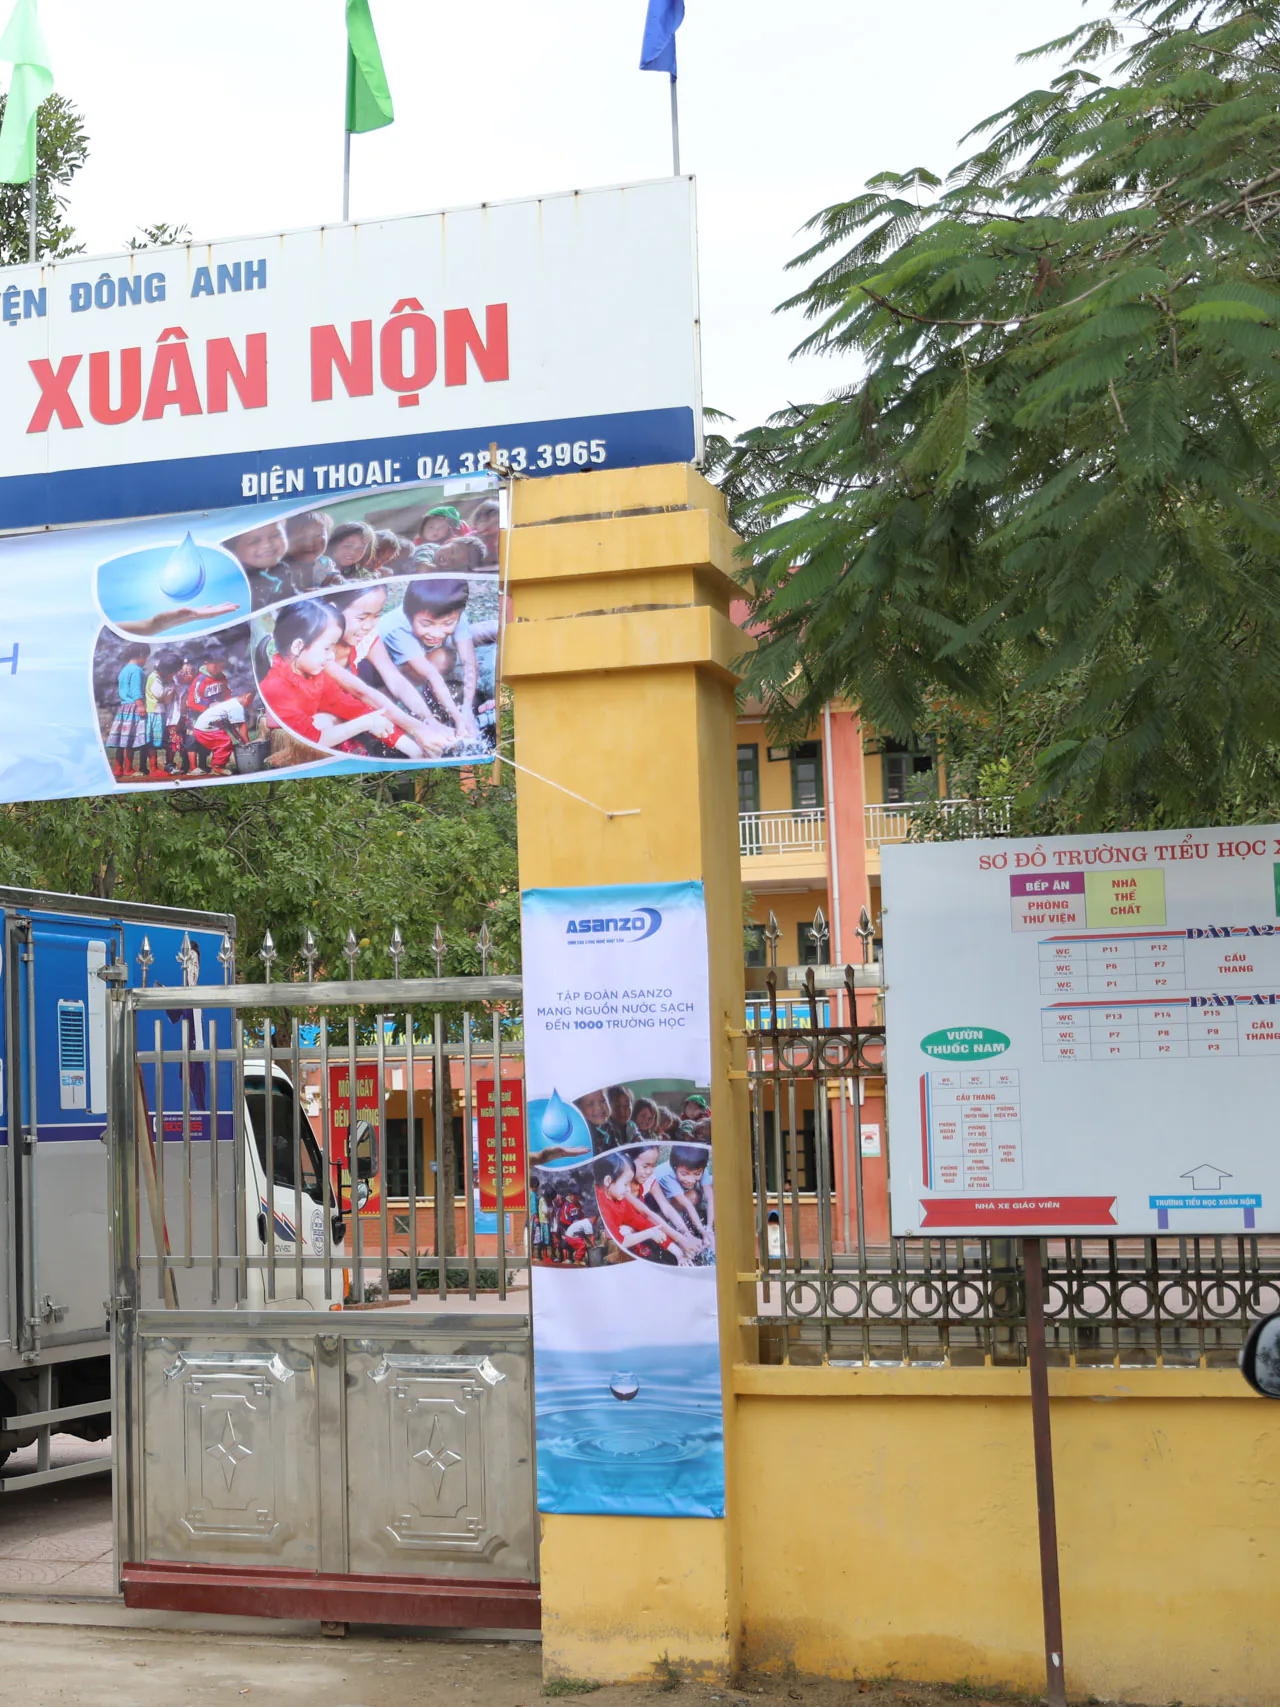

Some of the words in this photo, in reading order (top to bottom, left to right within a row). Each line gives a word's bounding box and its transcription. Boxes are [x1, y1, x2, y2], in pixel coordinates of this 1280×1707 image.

[70, 272, 167, 313] ĐÔNG
[191, 259, 267, 297] ANH
[26, 326, 268, 434] XUÂN
[310, 297, 509, 408] NỘN
[241, 466, 304, 501] ĐIỆN
[979, 852, 1008, 870] SƠ
[1014, 844, 1046, 868] ĐỒ
[1053, 844, 1148, 866] TRƯỜNG
[1154, 834, 1209, 860] TIỂU
[1217, 840, 1266, 860] HỌC
[1026, 879, 1049, 892] BẾP
[1028, 900, 1069, 910] PHÒNG
[1022, 914, 1046, 924] THƯ
[1048, 913, 1076, 924] VIỆN
[1218, 965, 1254, 973] THANG
[556, 990, 580, 1004] TẬP
[584, 989, 618, 1001] ĐOÀN
[622, 988, 673, 999] ASANZO
[537, 1006, 572, 1016] MANG
[576, 1002, 618, 1015] NGUỒN
[622, 1002, 656, 1014] NƯỚC
[660, 1003, 694, 1015] SẠCH
[545, 1018, 570, 1031] ĐẾN
[574, 1020, 603, 1030] 1000
[607, 1016, 655, 1029] TRƯỜNG
[659, 1017, 686, 1029] HỌC
[1245, 1032, 1280, 1040] THANG
[926, 1042, 969, 1054] THUỐC
[973, 1043, 1005, 1053] NAM
